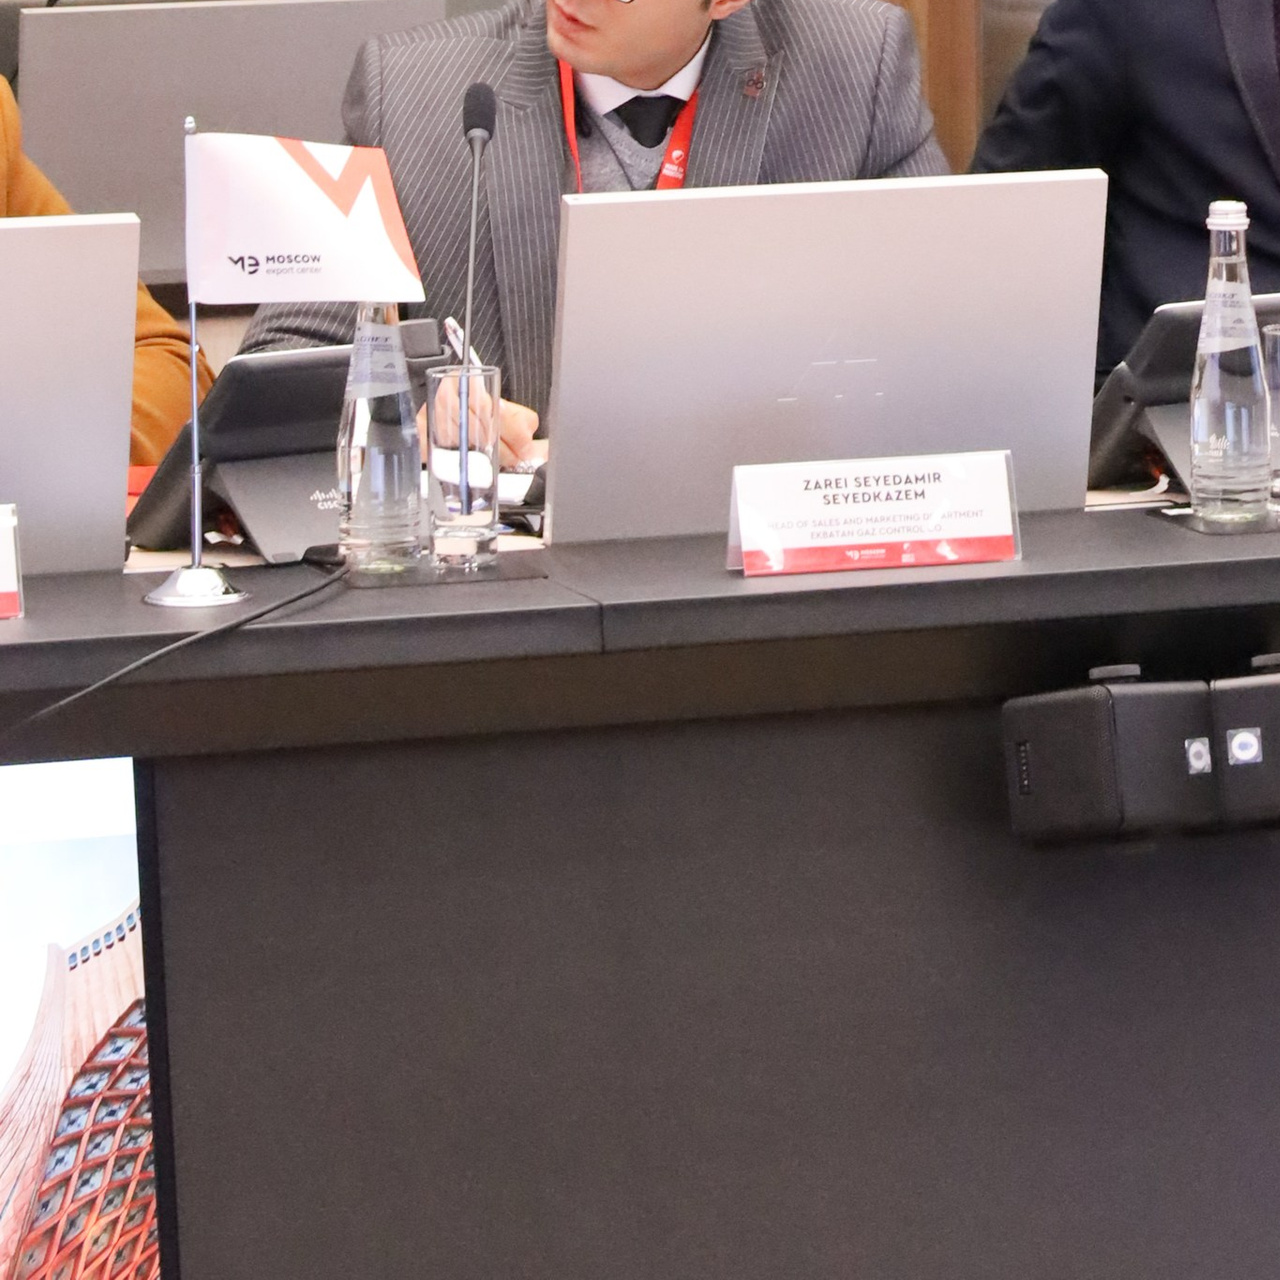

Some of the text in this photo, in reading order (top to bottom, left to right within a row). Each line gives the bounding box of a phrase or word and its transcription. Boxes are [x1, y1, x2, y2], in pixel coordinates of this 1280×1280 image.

[265, 254, 321, 264] MOSCOW
[265, 266, 322, 276] export center
[803, 472, 942, 491] ZAREI SEYEDAMIR
[823, 489, 926, 505] SEYEDKAZEM
[796, 519, 808, 529] OF
[812, 518, 841, 528] SALES
[843, 516, 863, 526] AND
[865, 513, 920, 524] MARKETING
[923, 509, 984, 521] DARTMENT
[810, 529, 854, 540] EKBATAN
[857, 527, 877, 537] GAZ
[879, 525, 924, 536] CONTROL
